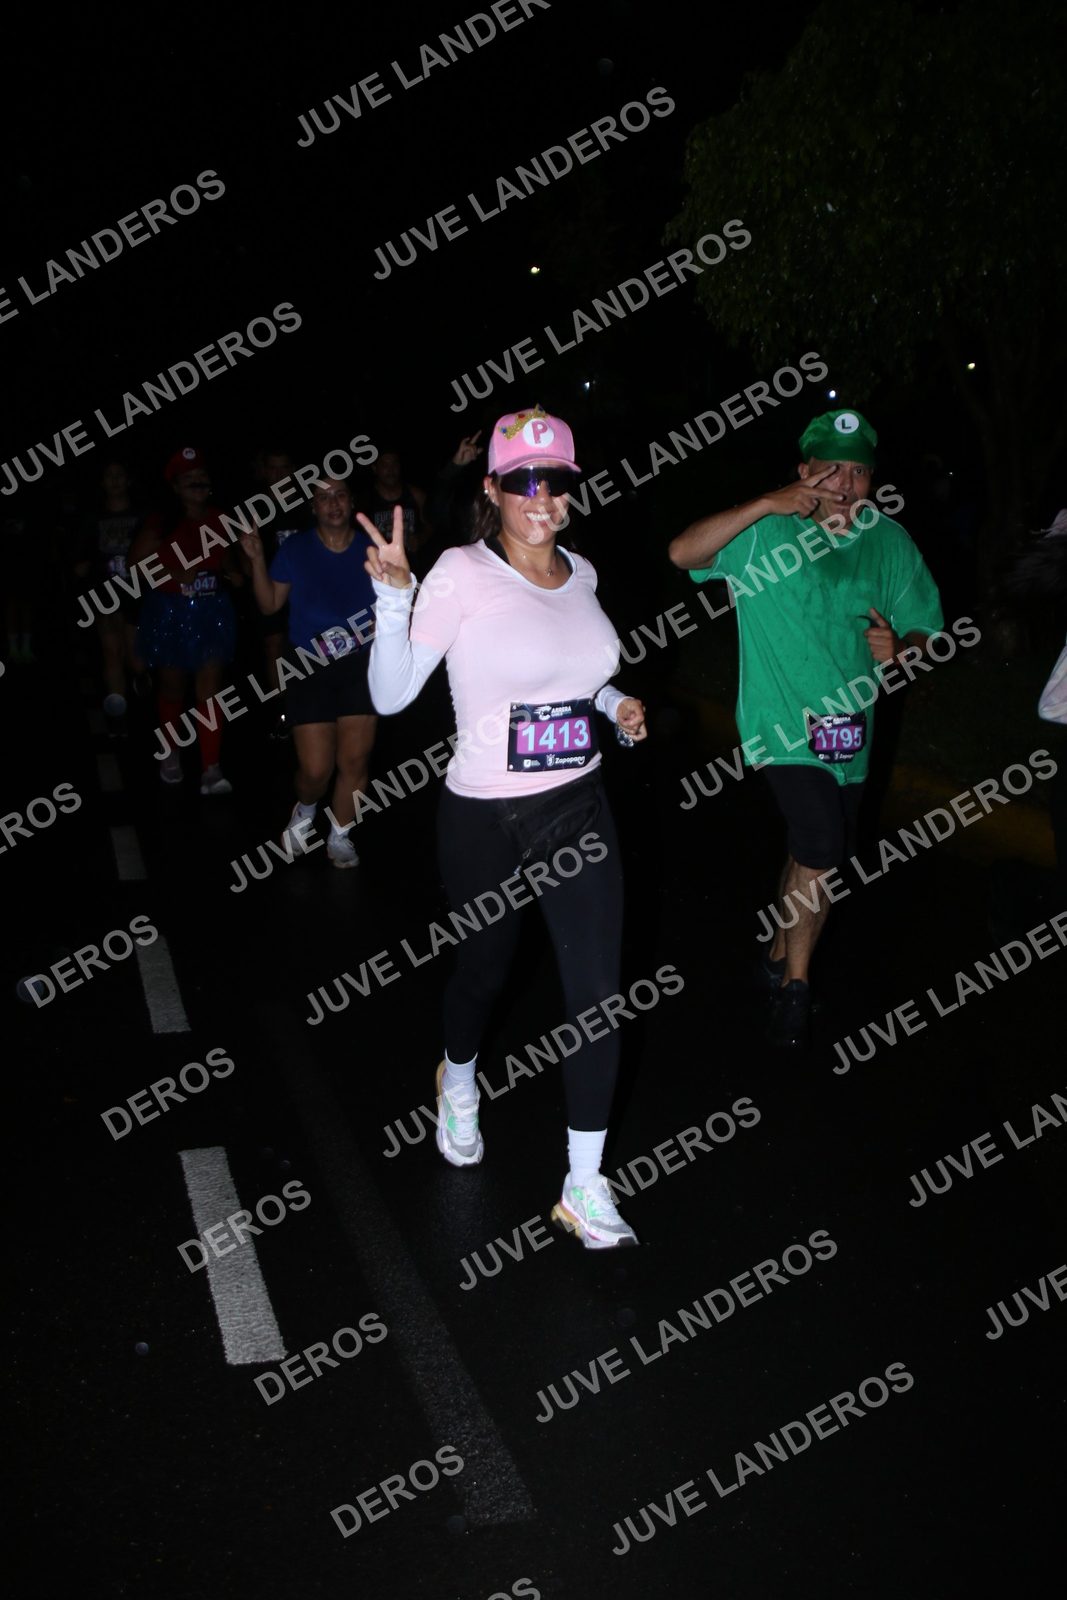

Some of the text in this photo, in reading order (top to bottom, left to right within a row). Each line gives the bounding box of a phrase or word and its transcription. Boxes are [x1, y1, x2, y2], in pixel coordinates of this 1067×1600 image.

[532, 420, 549, 444] P
[841, 418, 852, 430] L
[521, 719, 589, 752] 1413
[817, 727, 862, 749] 1795
